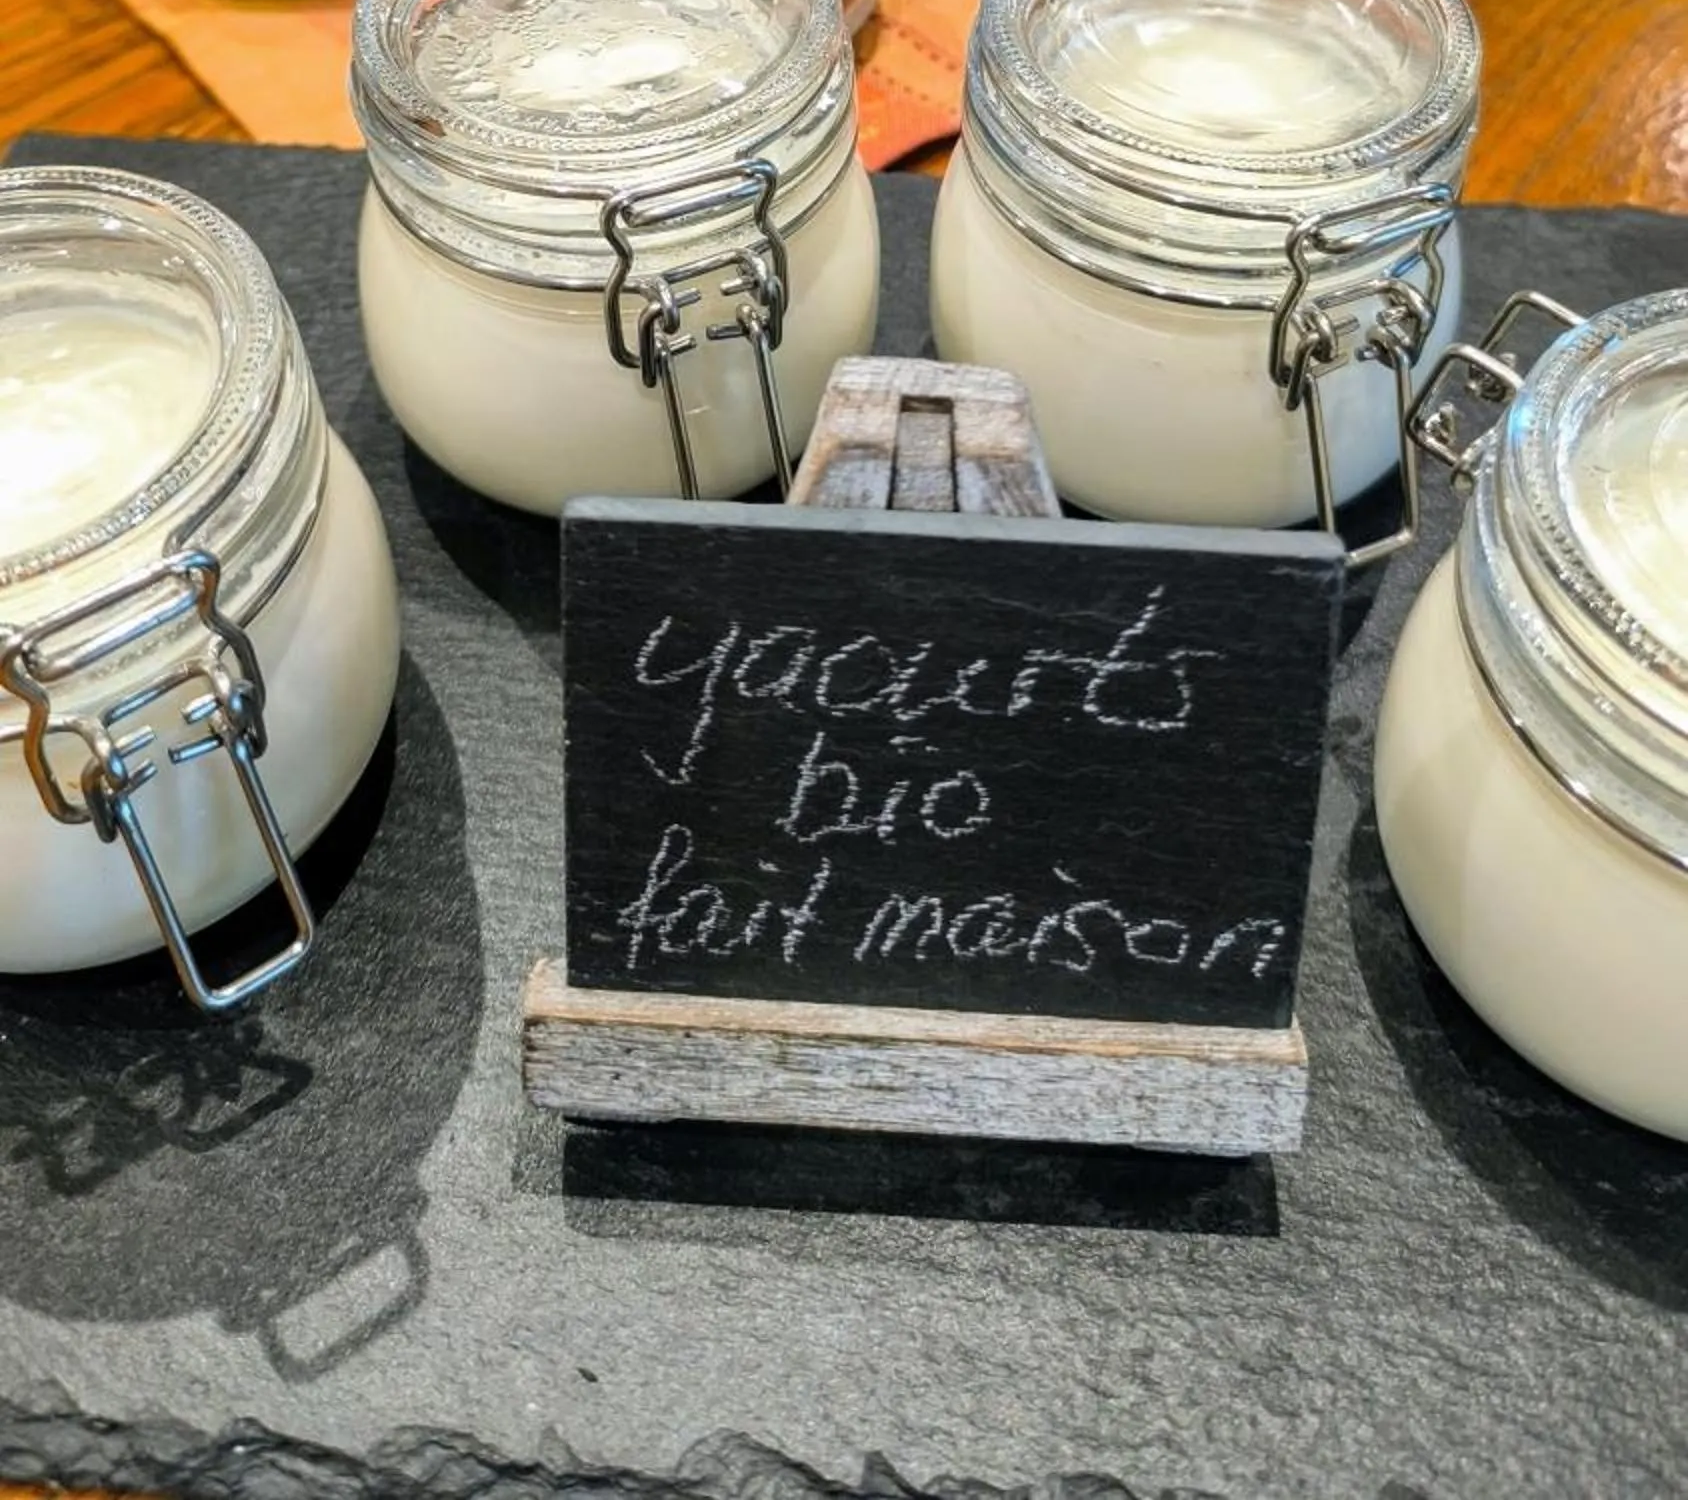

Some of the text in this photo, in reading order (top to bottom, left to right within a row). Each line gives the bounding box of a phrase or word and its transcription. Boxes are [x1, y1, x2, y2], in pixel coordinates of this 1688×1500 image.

[633, 584, 1225, 785] yaourts
[775, 731, 991, 846] bio
[617, 823, 1286, 980] fait maison
